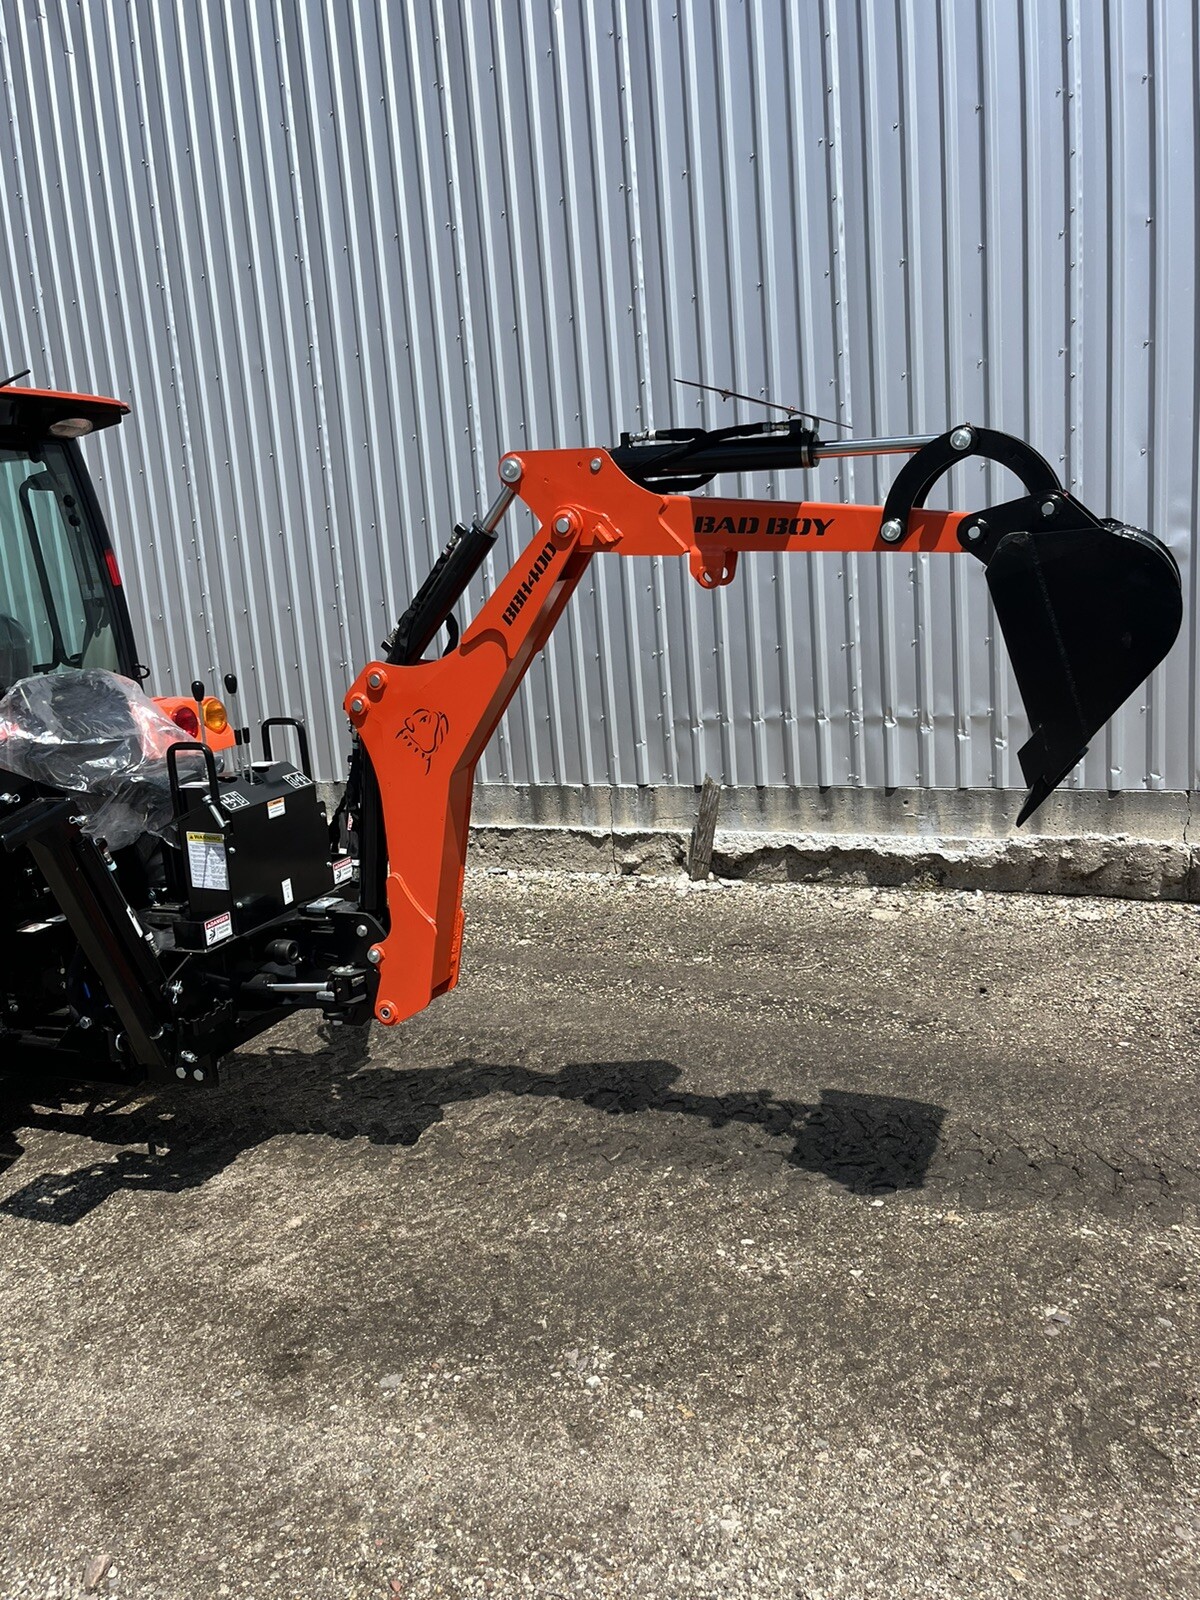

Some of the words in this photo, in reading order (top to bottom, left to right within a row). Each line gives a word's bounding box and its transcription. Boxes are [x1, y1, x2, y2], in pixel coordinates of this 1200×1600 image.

[694, 516, 760, 534] BAD
[765, 517, 835, 536] BOY
[501, 541, 557, 627] BBH400
